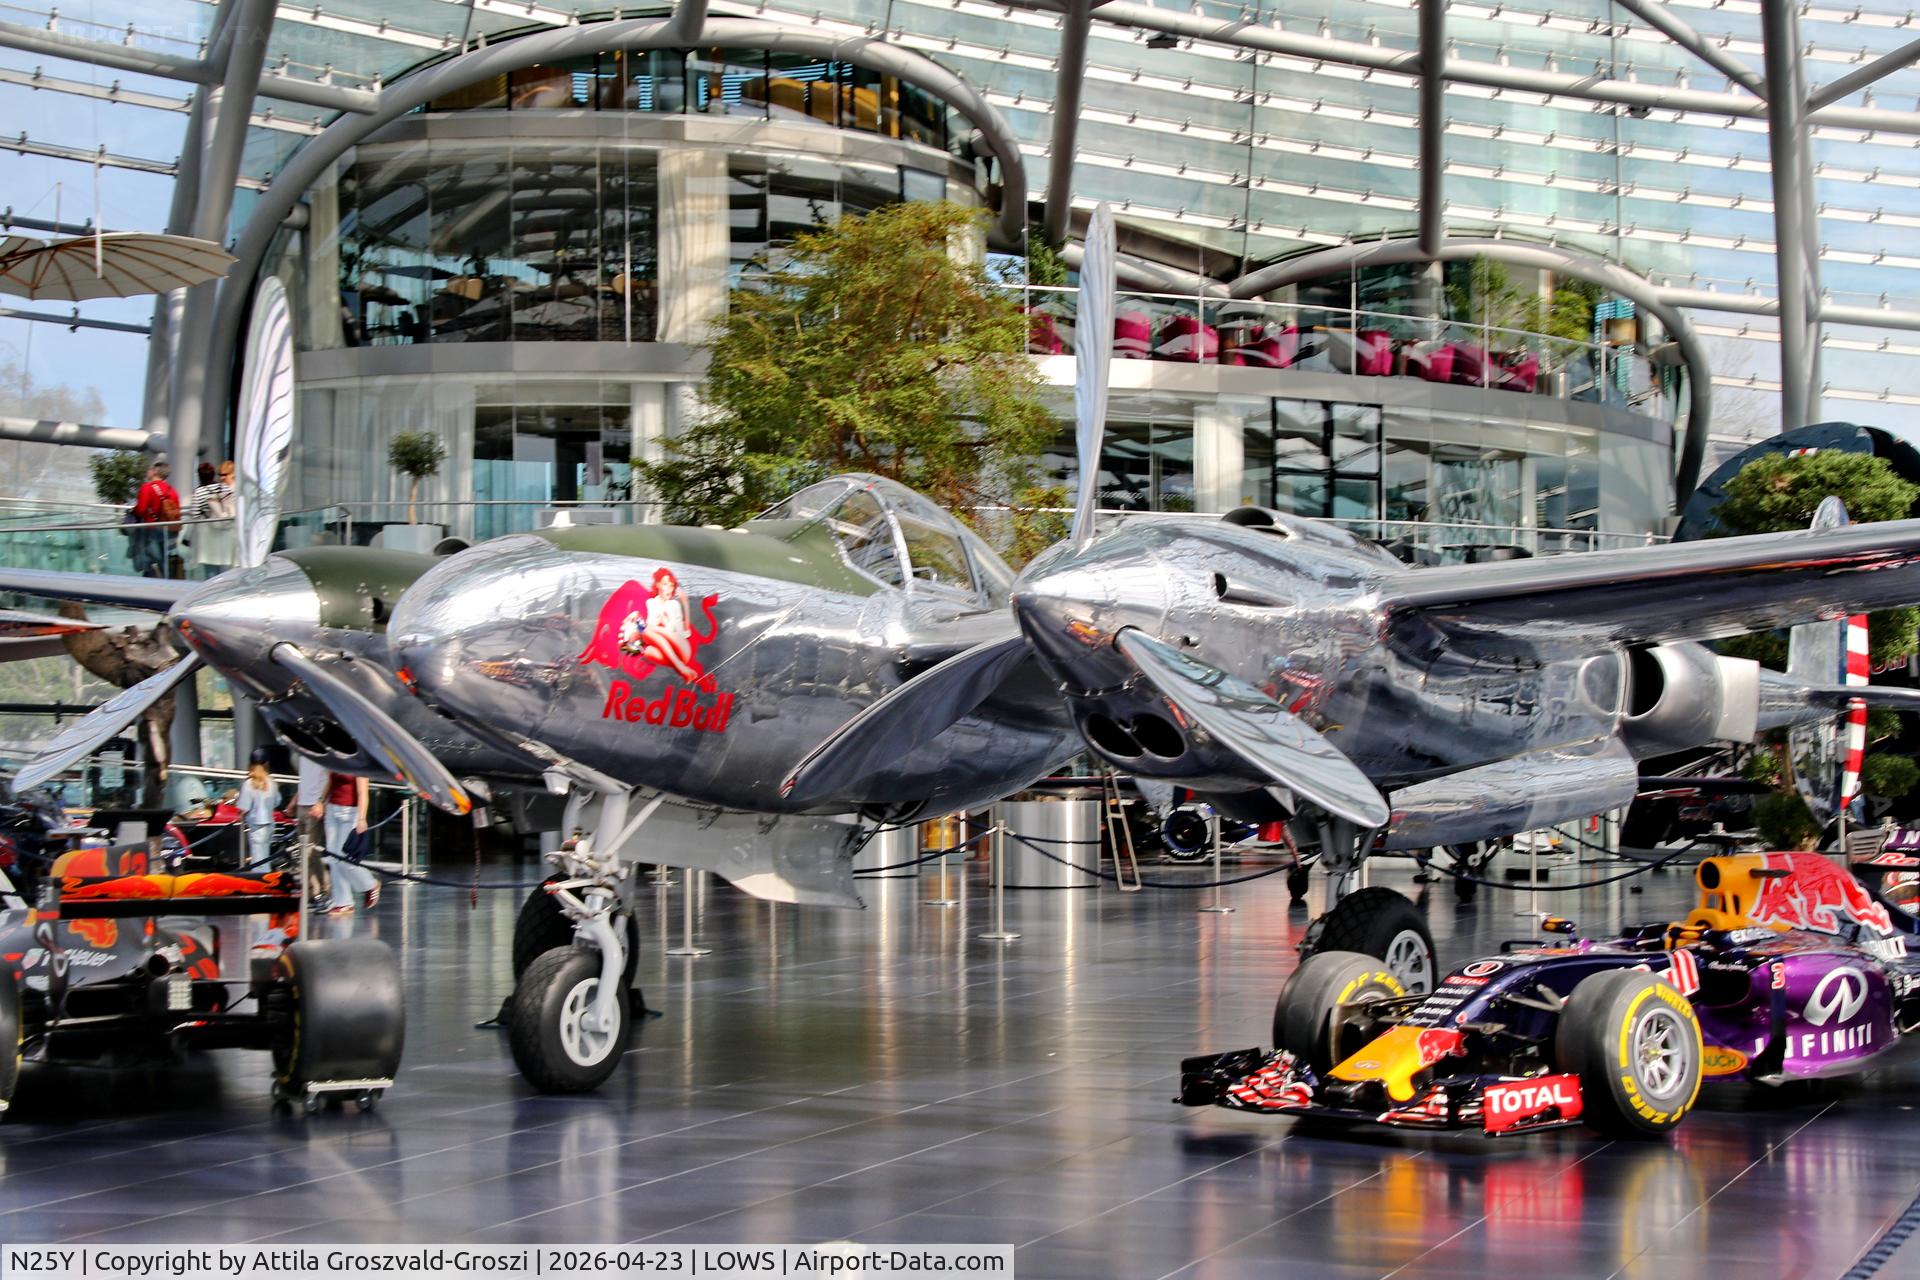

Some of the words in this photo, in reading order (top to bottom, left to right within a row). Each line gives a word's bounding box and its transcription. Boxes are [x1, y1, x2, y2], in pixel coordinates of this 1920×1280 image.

[602, 680, 674, 726] Red
[669, 689, 735, 733] Bull
[1373, 971, 1406, 997] ZER
[1485, 1083, 1574, 1114] TOTAL
